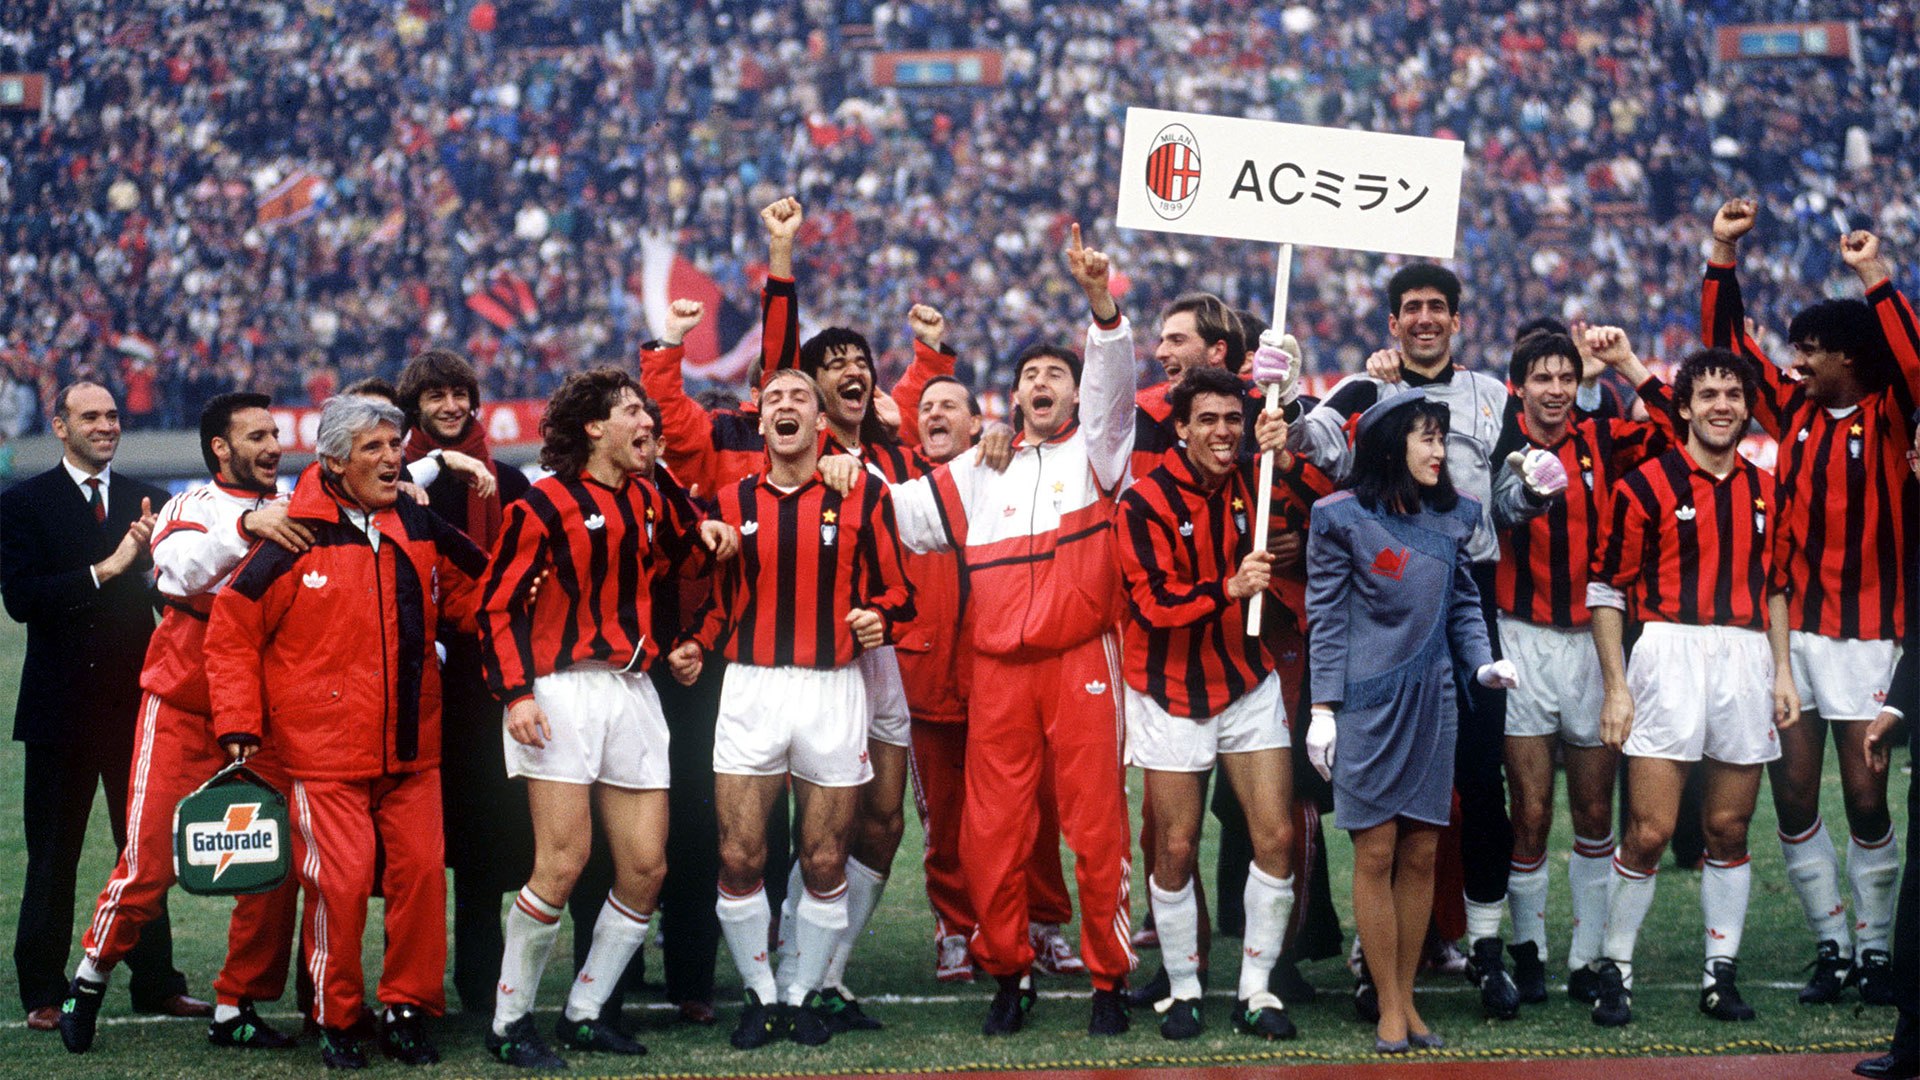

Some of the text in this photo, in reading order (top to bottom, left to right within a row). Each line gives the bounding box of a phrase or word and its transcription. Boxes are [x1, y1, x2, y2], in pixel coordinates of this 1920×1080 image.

[1161, 133, 1192, 145] MILAN
[1229, 159, 1430, 213] ACミラン
[1159, 201, 1183, 211] 1899
[193, 830, 272, 852] Gatorade
